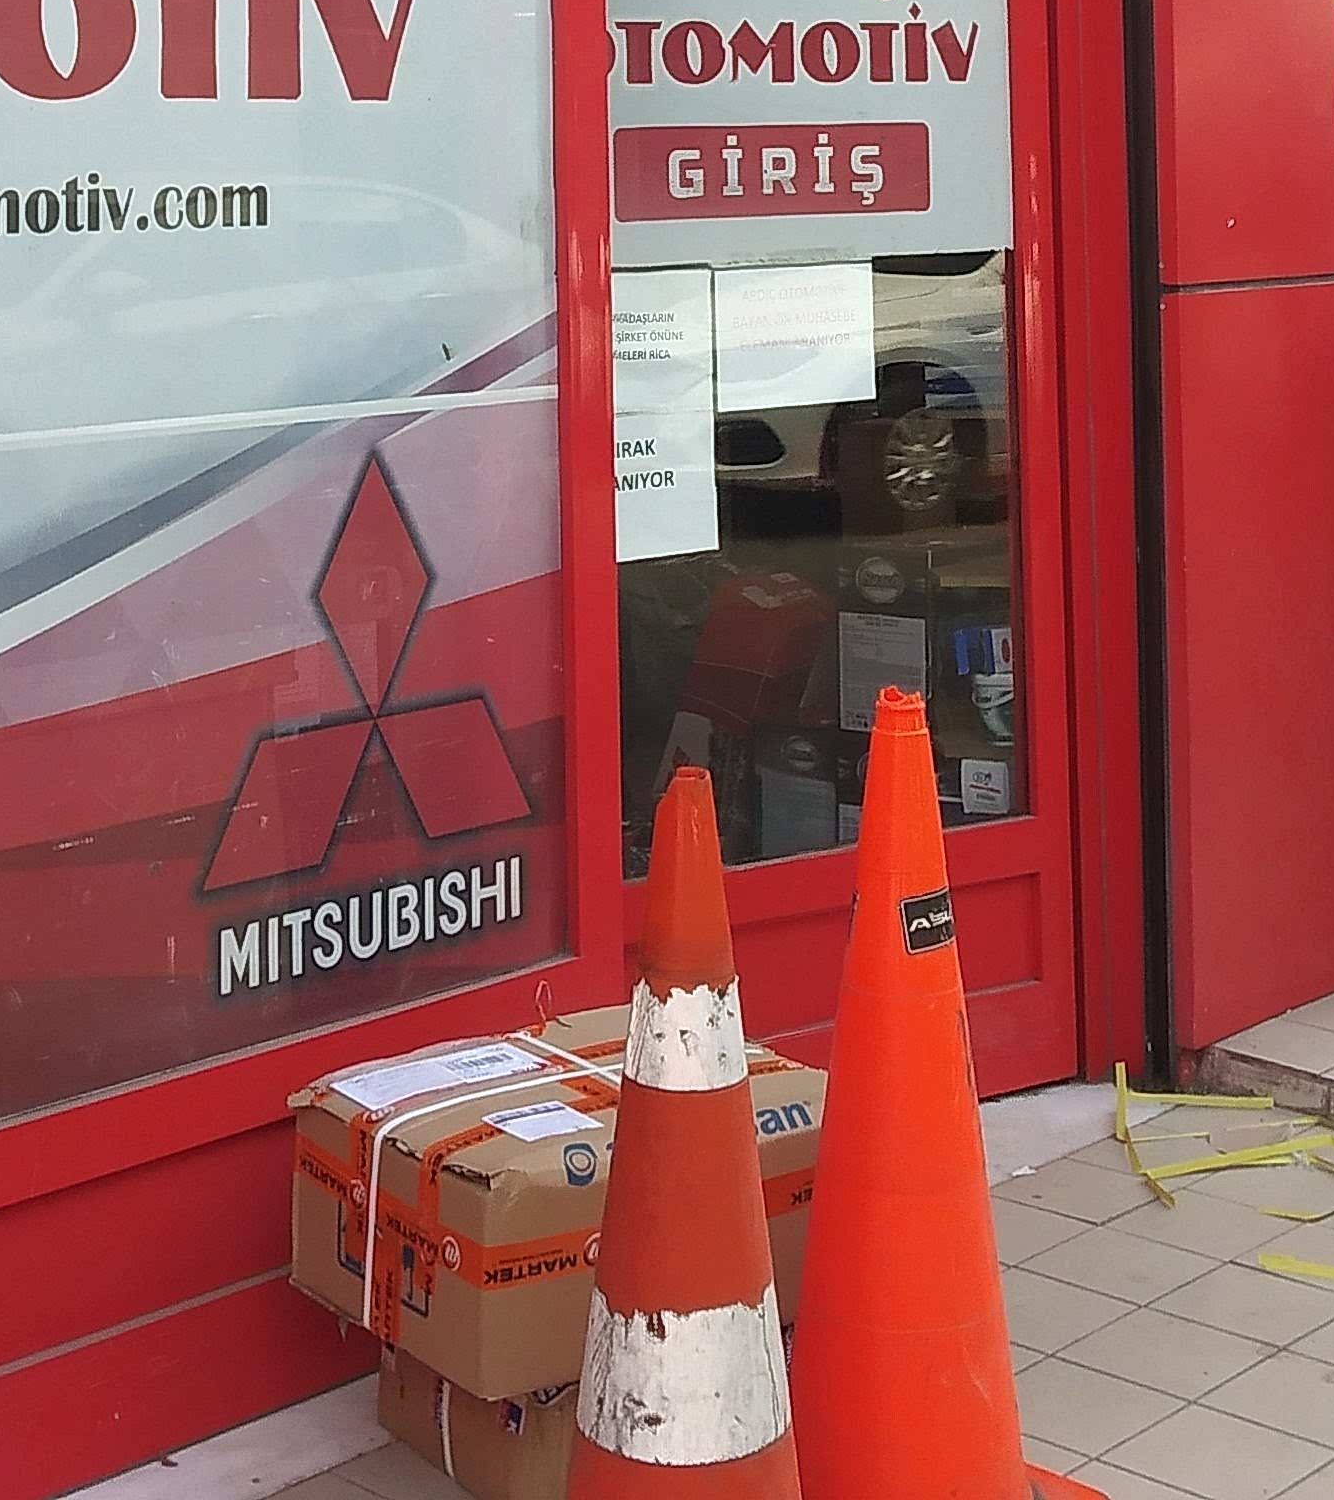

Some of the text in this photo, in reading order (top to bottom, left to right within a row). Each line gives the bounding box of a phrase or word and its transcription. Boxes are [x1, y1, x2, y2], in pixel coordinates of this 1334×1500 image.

[667, 134, 885, 206] GİRİŞ
[219, 856, 523, 996] MITSUBISHI
[300, 1154, 348, 1197] MARTEK
[483, 1252, 577, 1285] MARTEK
